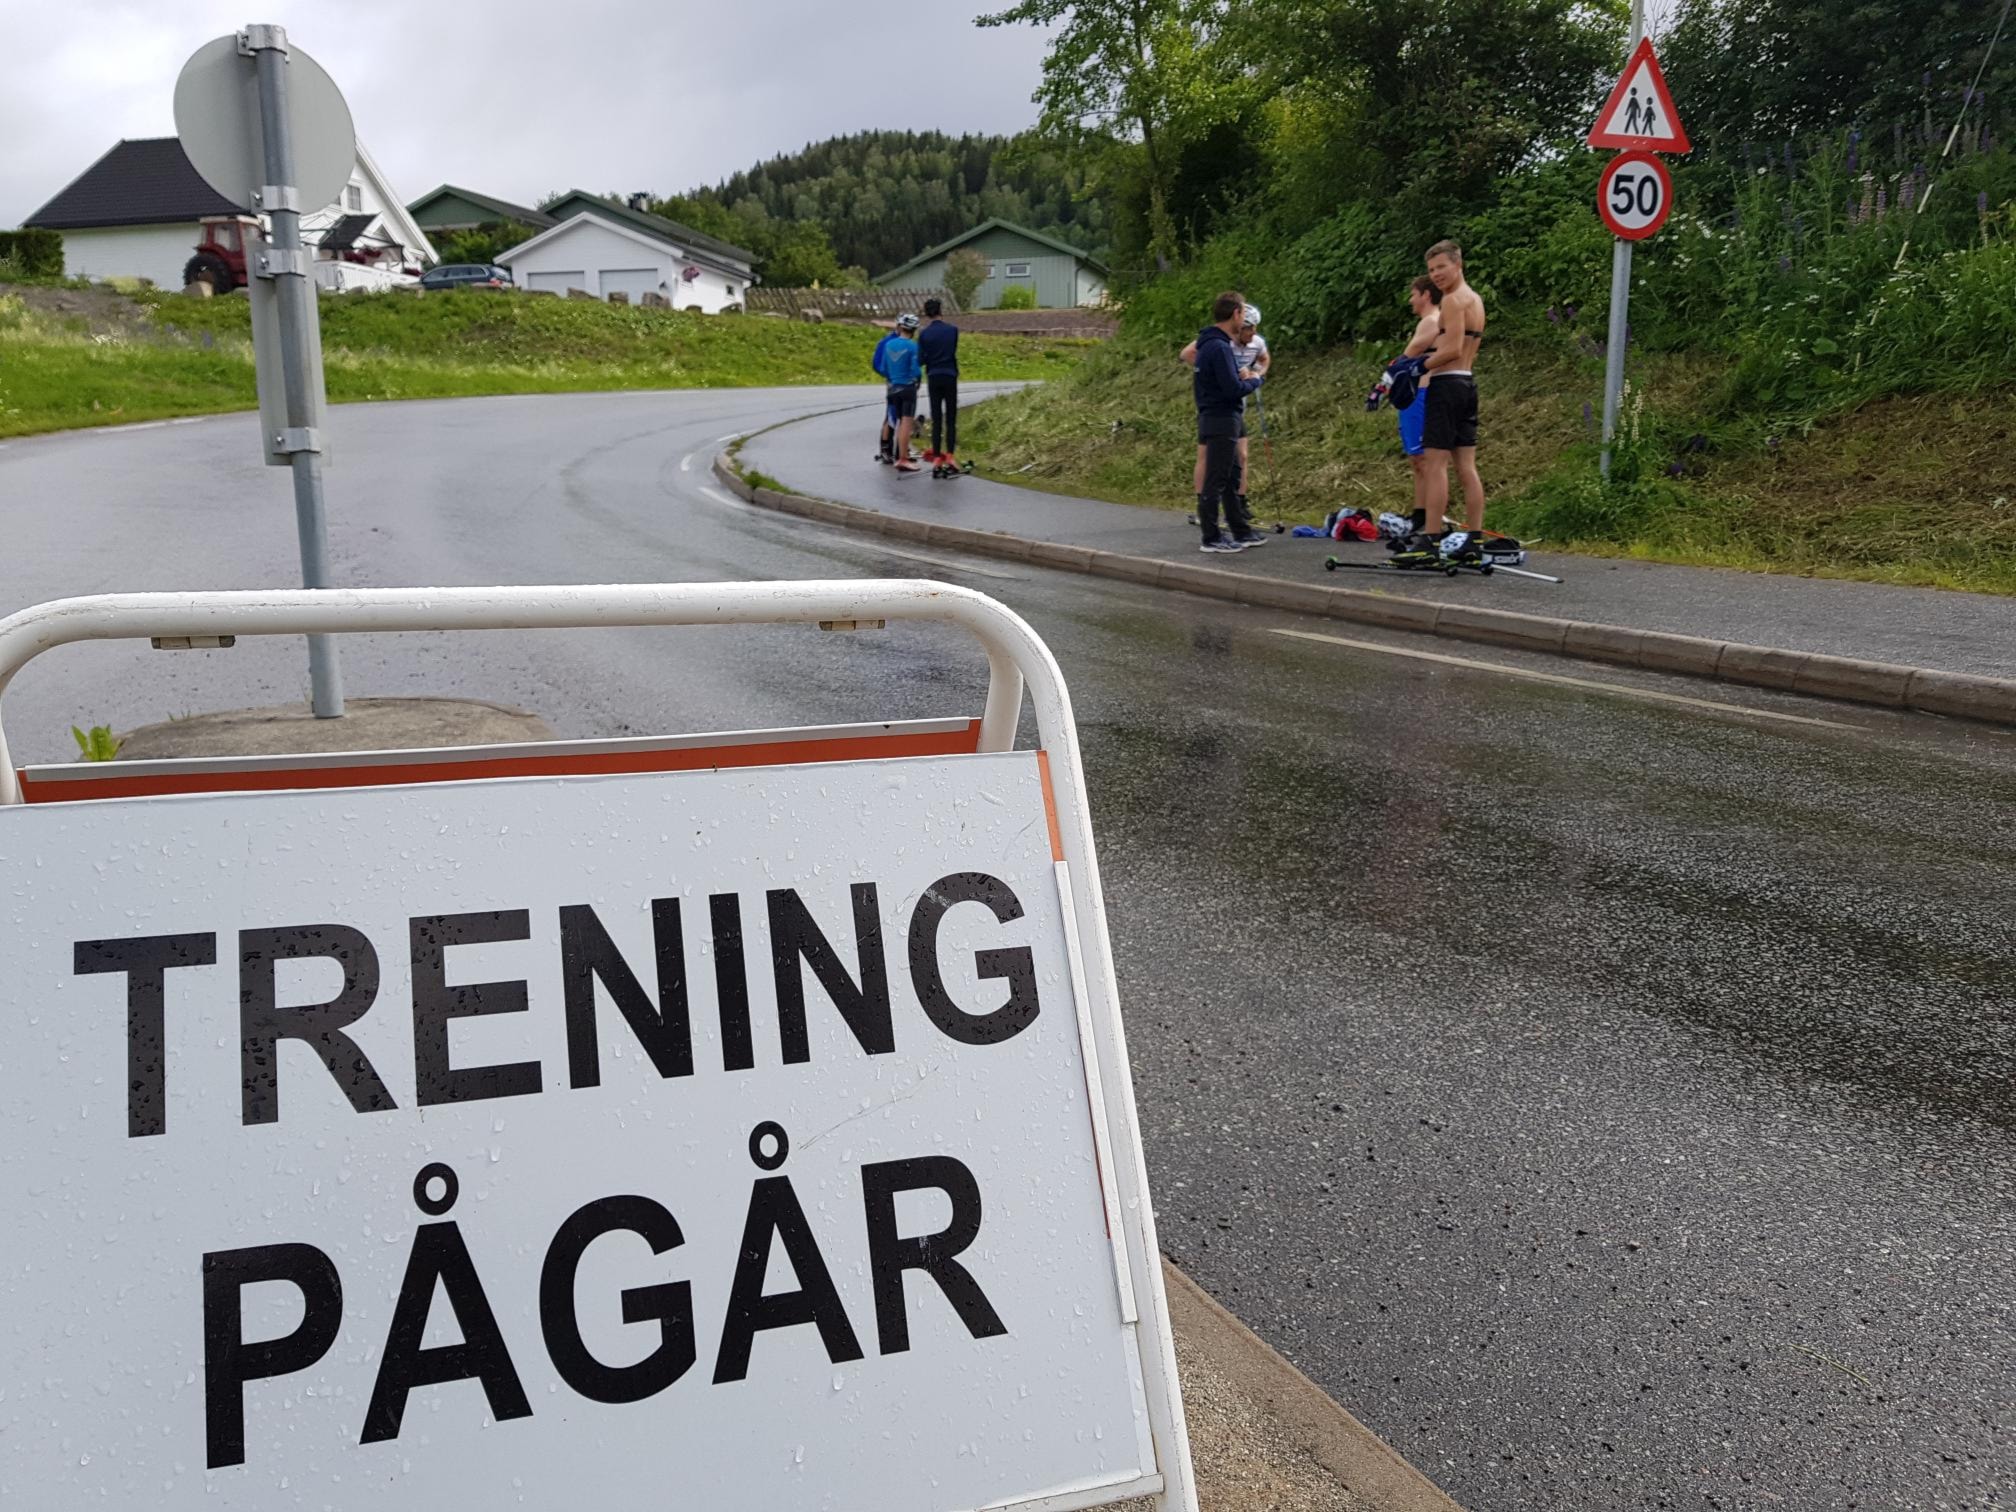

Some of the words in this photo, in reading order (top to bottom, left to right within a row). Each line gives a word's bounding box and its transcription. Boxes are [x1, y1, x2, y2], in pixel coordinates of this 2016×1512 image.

[1612, 174, 1659, 216] 50
[74, 872, 1040, 1138] TRENING
[203, 1120, 1008, 1469] PÅGÅR
